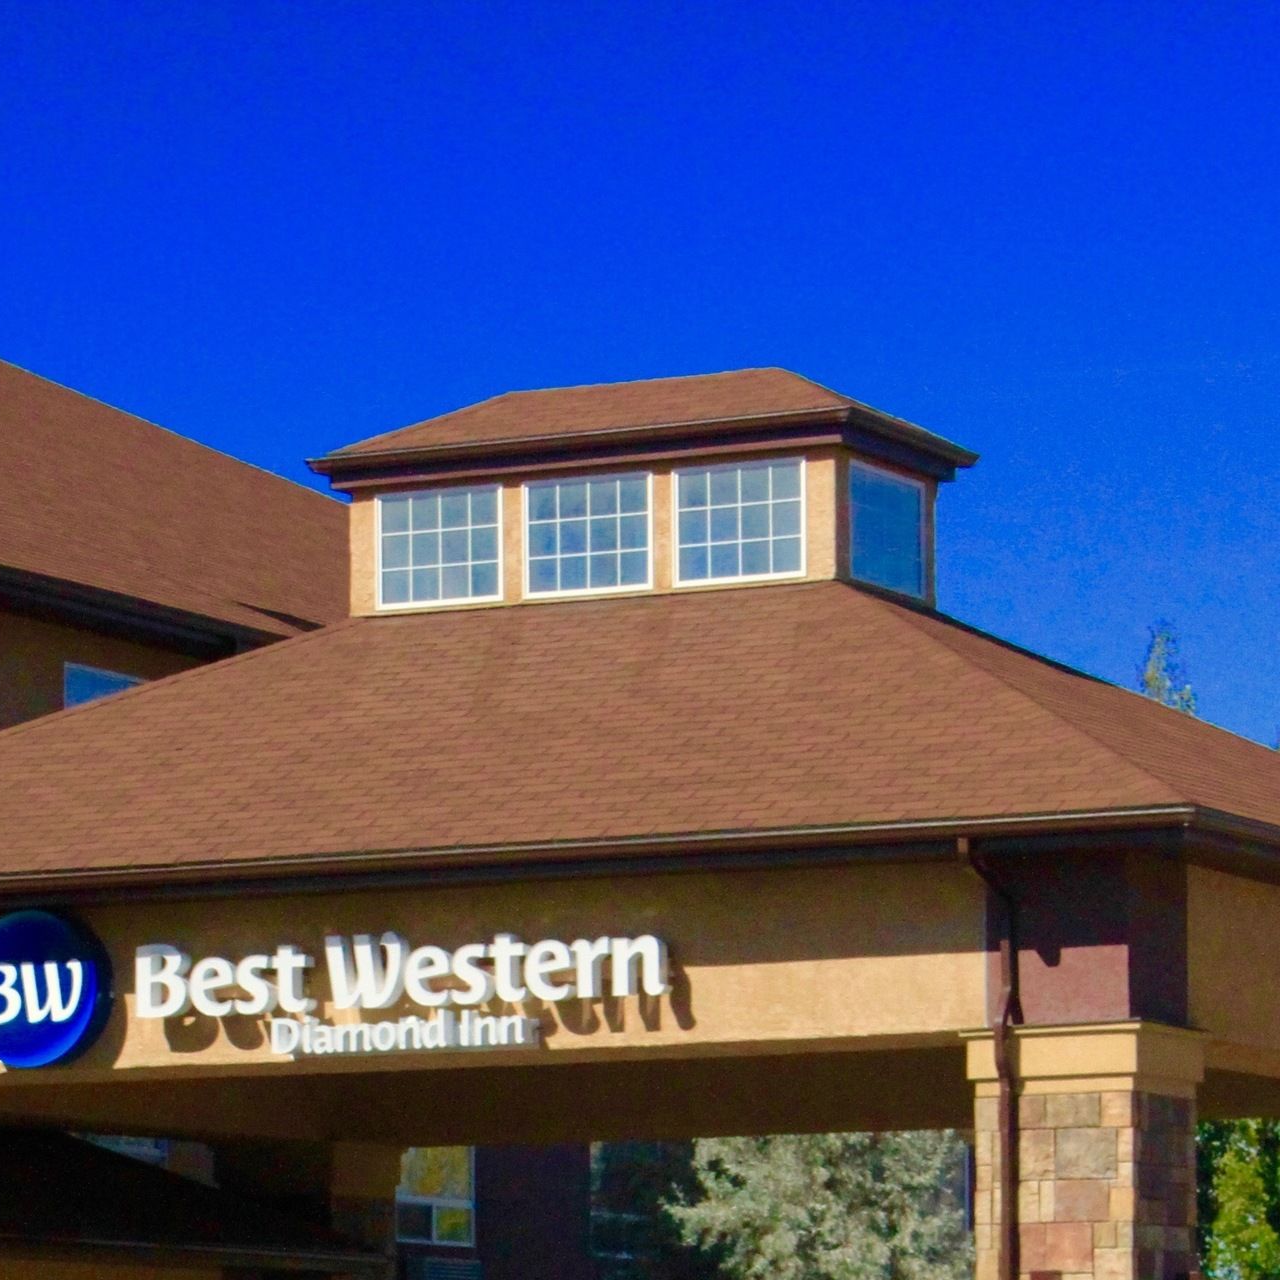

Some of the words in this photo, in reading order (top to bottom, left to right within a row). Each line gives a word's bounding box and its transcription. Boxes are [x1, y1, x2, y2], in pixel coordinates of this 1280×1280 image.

[134, 944, 311, 1018] Best
[324, 931, 668, 1010] Western
[270, 1008, 449, 1055] Diamond
[460, 1009, 527, 1046] Inn
